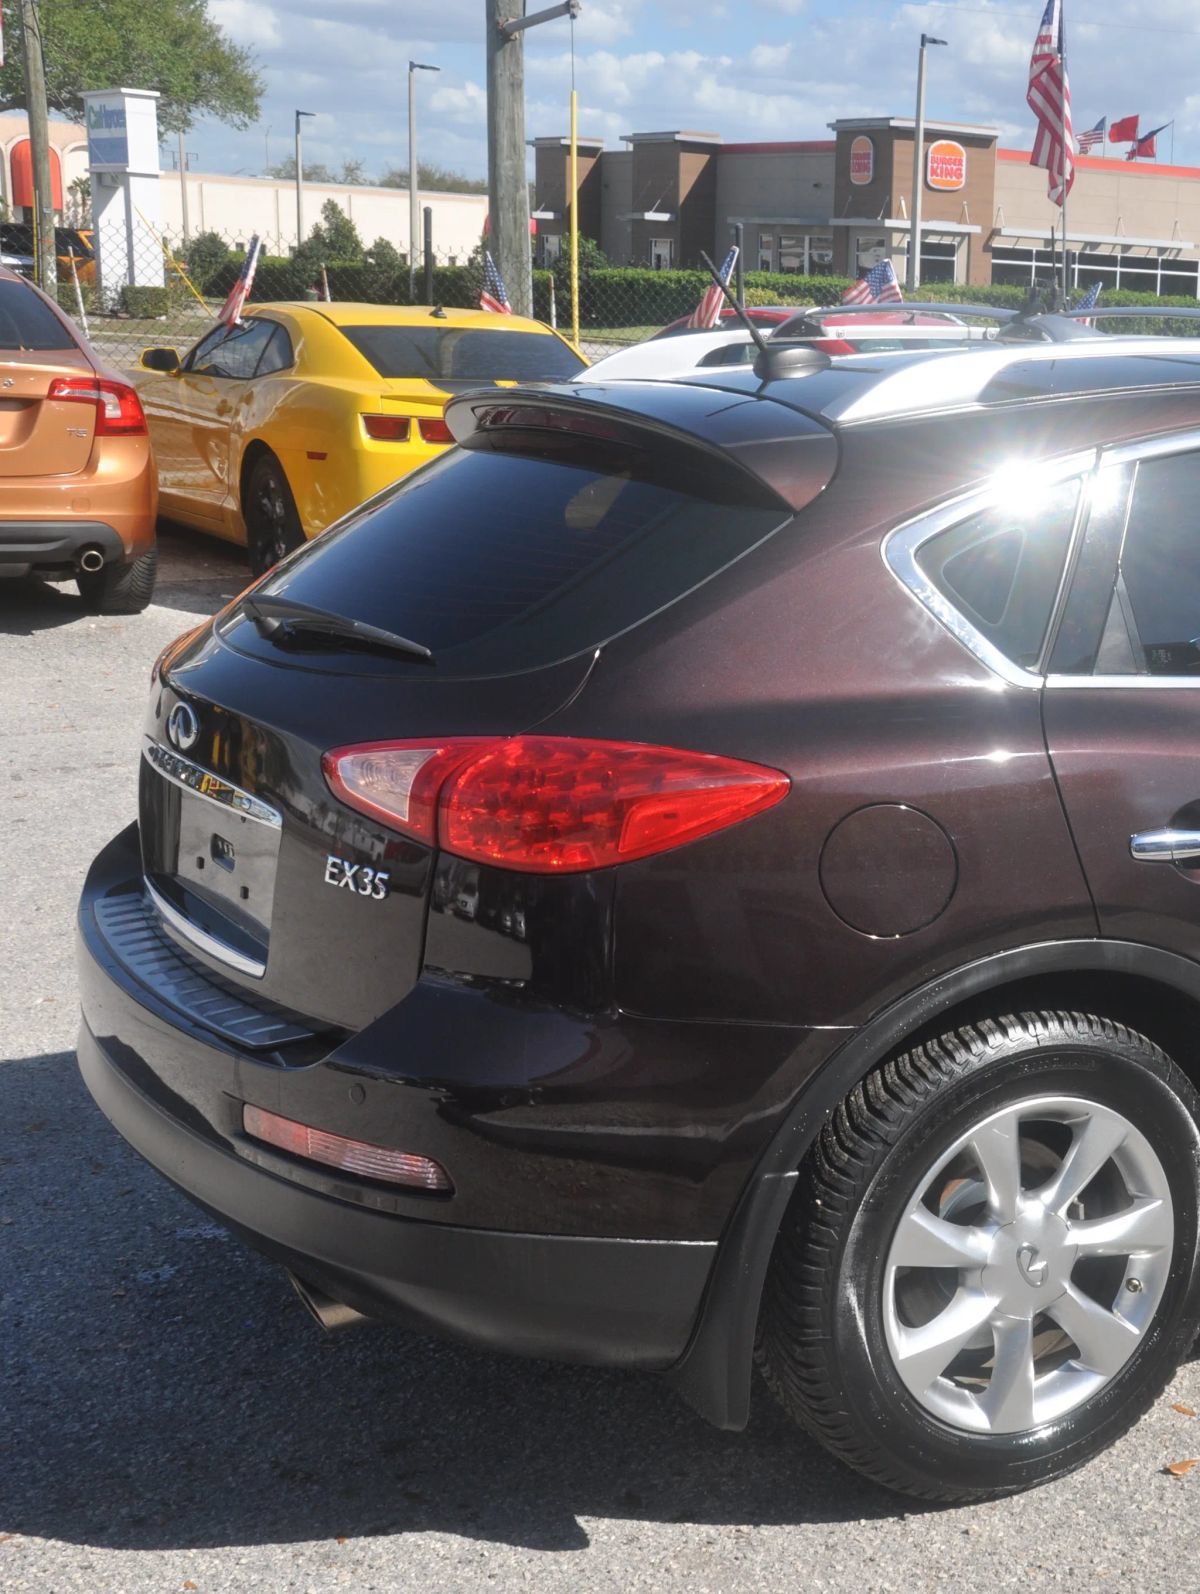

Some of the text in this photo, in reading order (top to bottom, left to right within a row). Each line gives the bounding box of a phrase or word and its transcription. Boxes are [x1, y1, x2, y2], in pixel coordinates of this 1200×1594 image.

[930, 155, 964, 168] BURGER
[930, 165, 963, 179] KING
[325, 855, 390, 900] EX35
